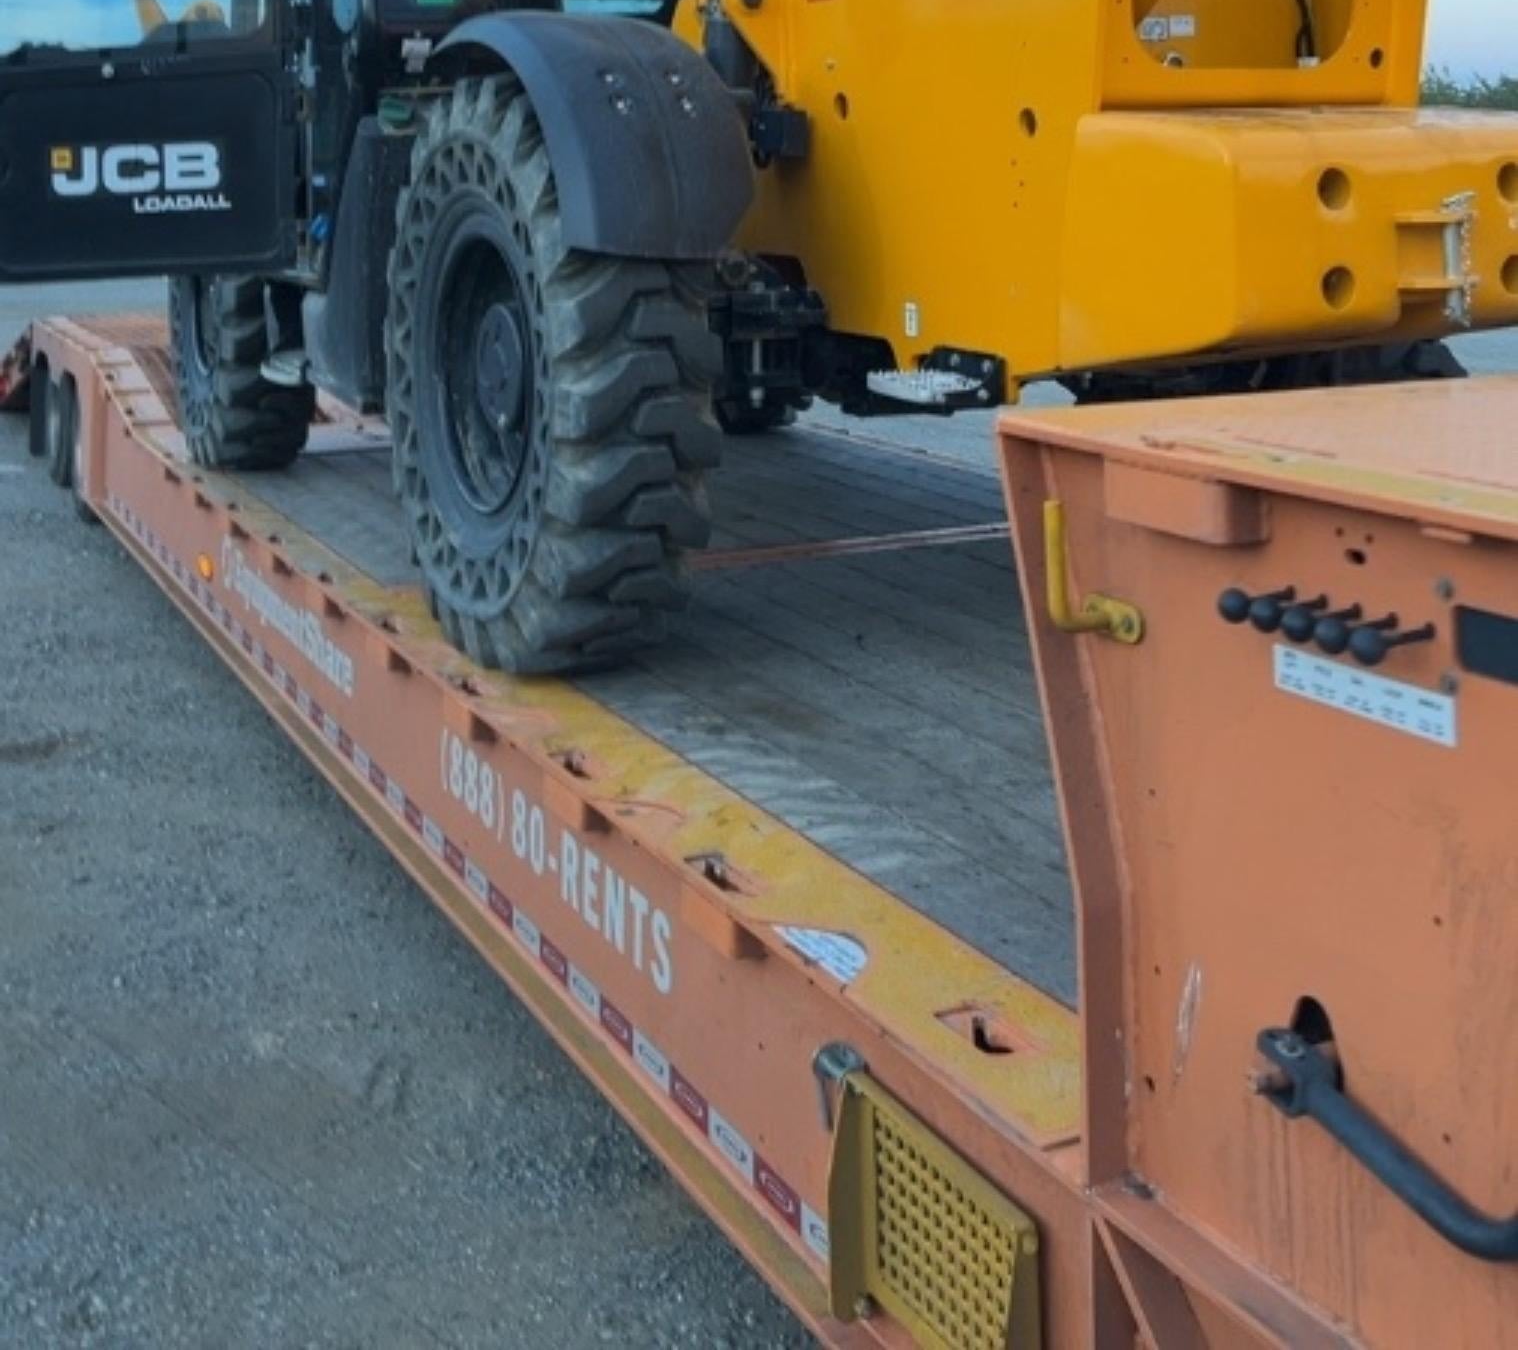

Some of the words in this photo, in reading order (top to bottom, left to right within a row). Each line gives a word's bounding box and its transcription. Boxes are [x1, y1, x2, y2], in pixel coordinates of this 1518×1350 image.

[51, 141, 221, 196] JCB
[133, 193, 232, 214] LOADALL
[440, 728, 505, 844] (888)
[512, 788, 674, 994] 80-RENTS
